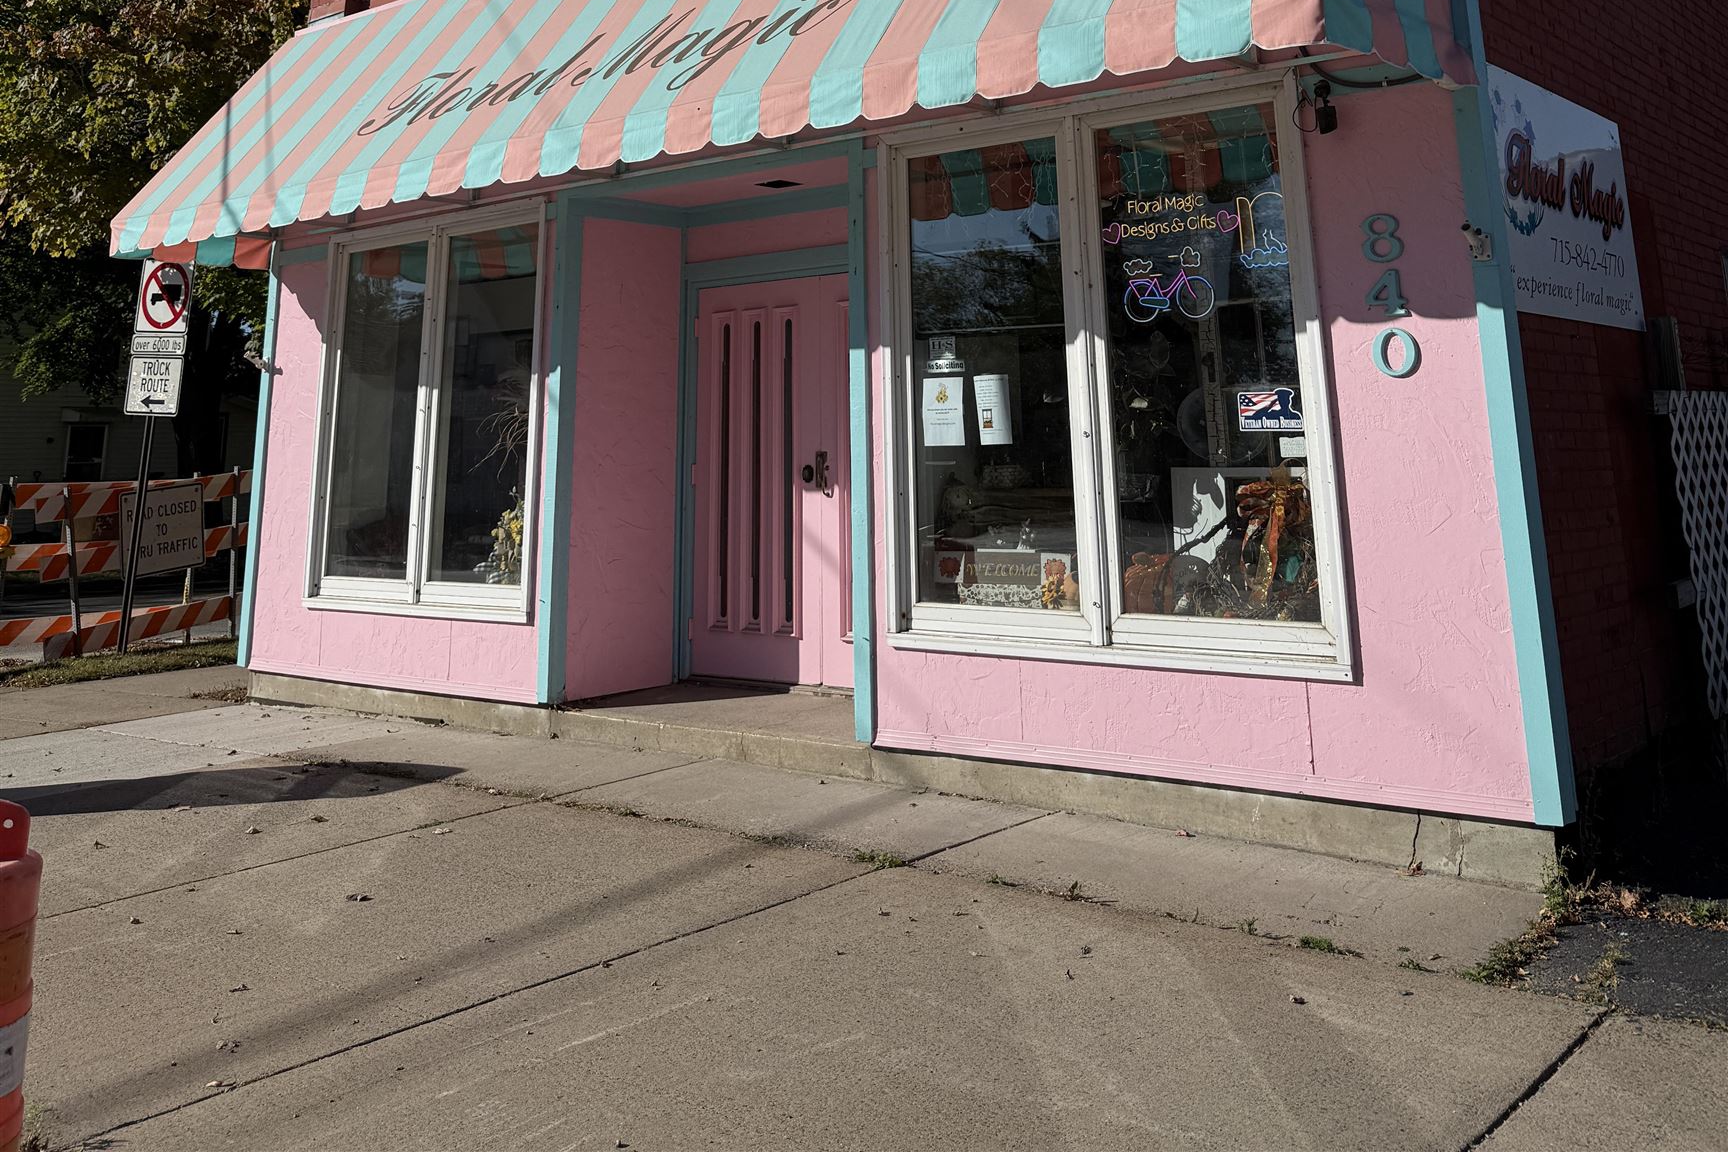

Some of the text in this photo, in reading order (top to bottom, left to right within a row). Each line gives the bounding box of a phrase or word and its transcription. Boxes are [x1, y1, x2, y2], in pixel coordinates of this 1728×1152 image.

[357, 33, 606, 137] Floral
[1506, 131, 1625, 241] Floral Magic
[1127, 193, 1205, 214] Floral Magic
[1121, 214, 1217, 240] Designs & Gifts
[1550, 237, 1625, 278] 715-842-4770
[1575, 281, 1604, 307] floral
[135, 339, 182, 351] over 6000 lbs
[143, 361, 171, 376] TRUCK
[140, 378, 170, 393] ROUTE
[126, 500, 197, 523] RD CLOSED
[156, 523, 168, 536] TO
[157, 536, 198, 555] TRAFFIC
[966, 562, 1040, 577] WELCOME
